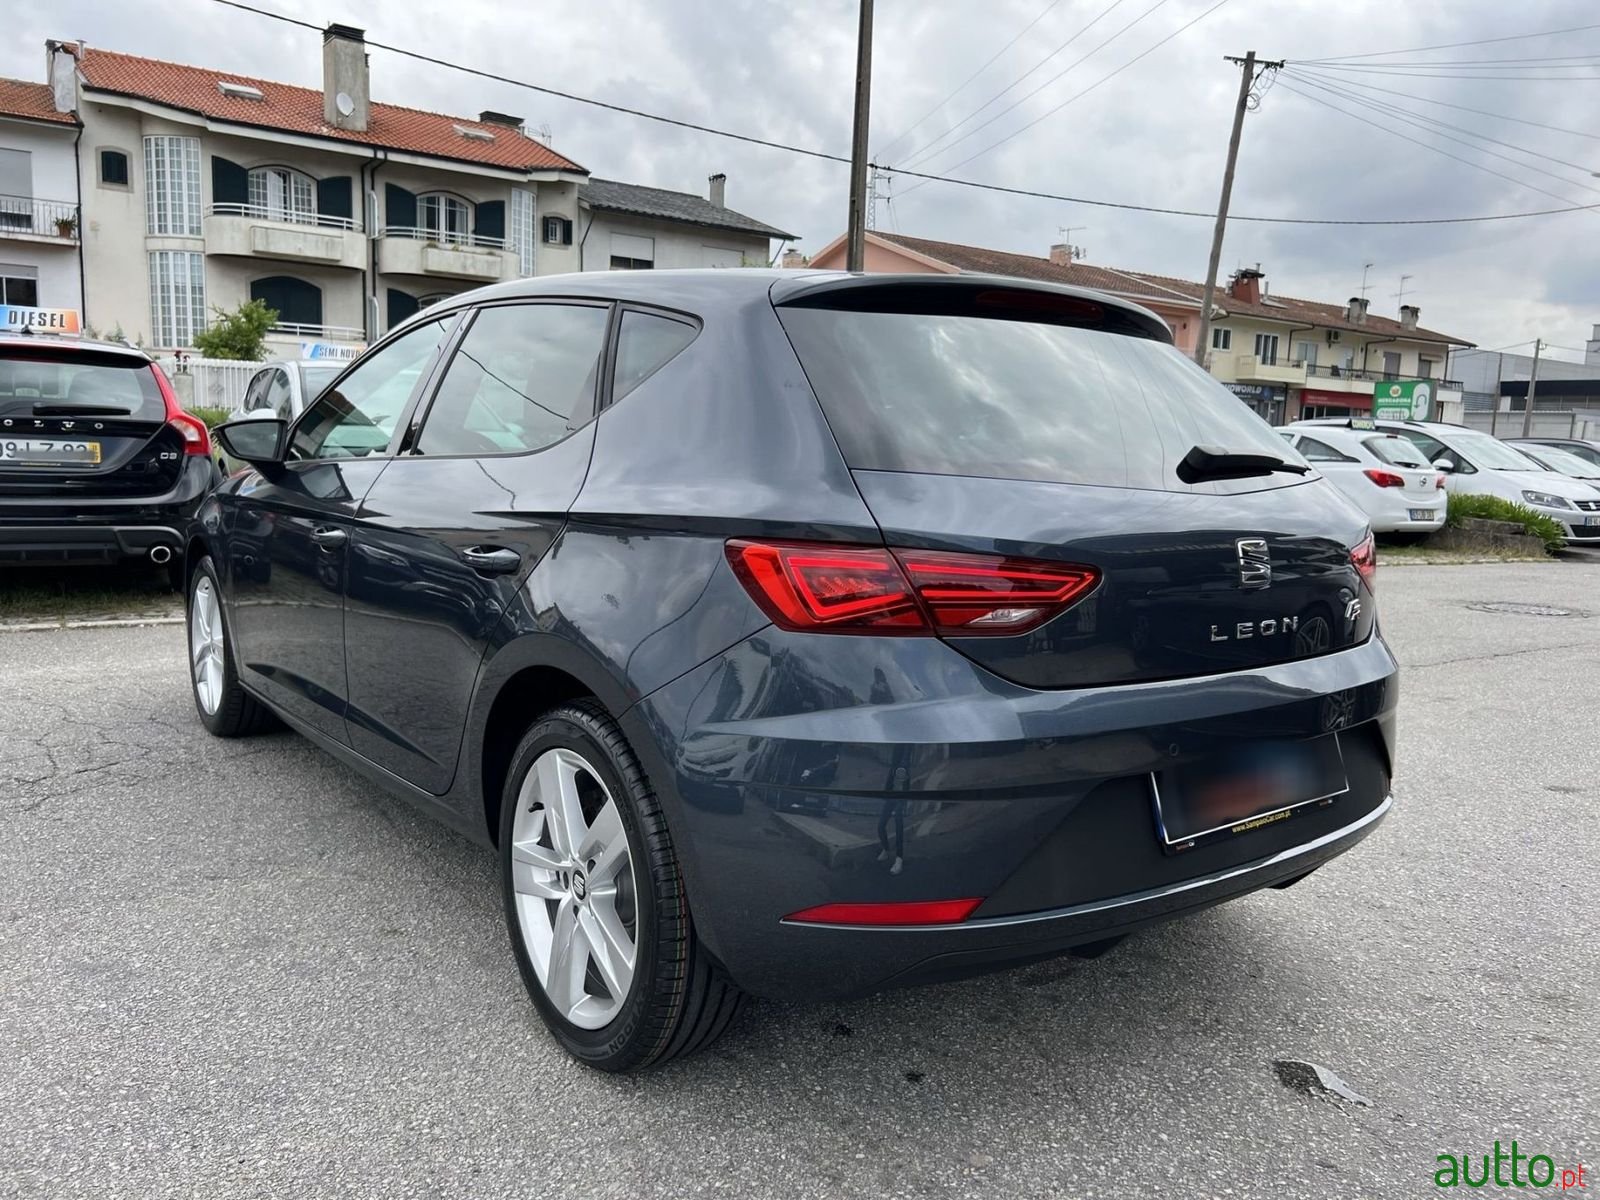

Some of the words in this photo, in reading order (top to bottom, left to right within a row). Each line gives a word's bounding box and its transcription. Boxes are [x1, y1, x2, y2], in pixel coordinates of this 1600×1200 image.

[8, 310, 66, 328] DIESEL
[320, 346, 338, 358] SEMI
[1210, 616, 1299, 642] LEON
